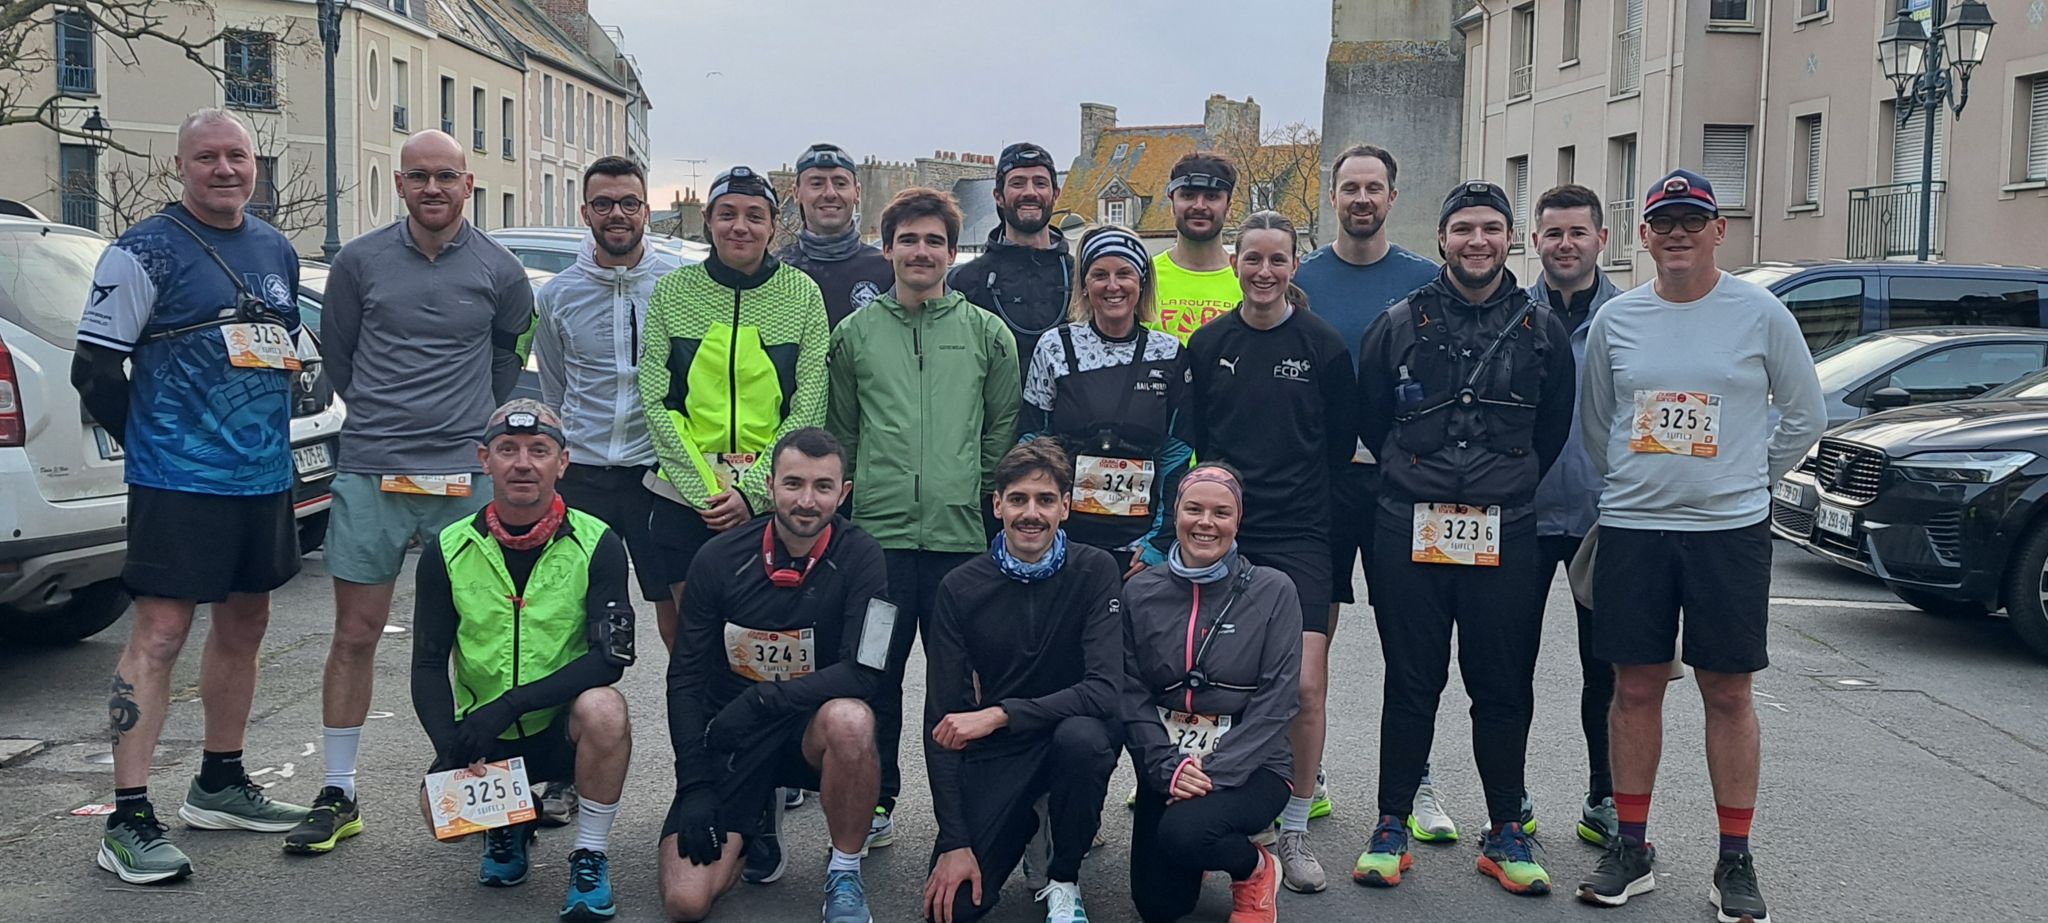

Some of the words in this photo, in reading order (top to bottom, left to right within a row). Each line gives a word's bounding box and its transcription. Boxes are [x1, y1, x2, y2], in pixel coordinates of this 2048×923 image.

[1161, 298, 1177, 306] LA
[1179, 299, 1221, 307] ROUTE
[251, 324, 281, 345] 325
[1273, 365, 1299, 378] FCD
[1660, 407, 1697, 430] 325
[1704, 416, 1712, 431] 2
[1103, 474, 1134, 492] 324
[1138, 481, 1145, 492] 5
[1444, 519, 1479, 540] 323
[1486, 526, 1493, 540] 6
[755, 644, 792, 663] 324
[800, 649, 807, 662] 3
[1173, 728, 1208, 750] 324
[464, 778, 506, 806] 325
[513, 781, 522, 796] 6
